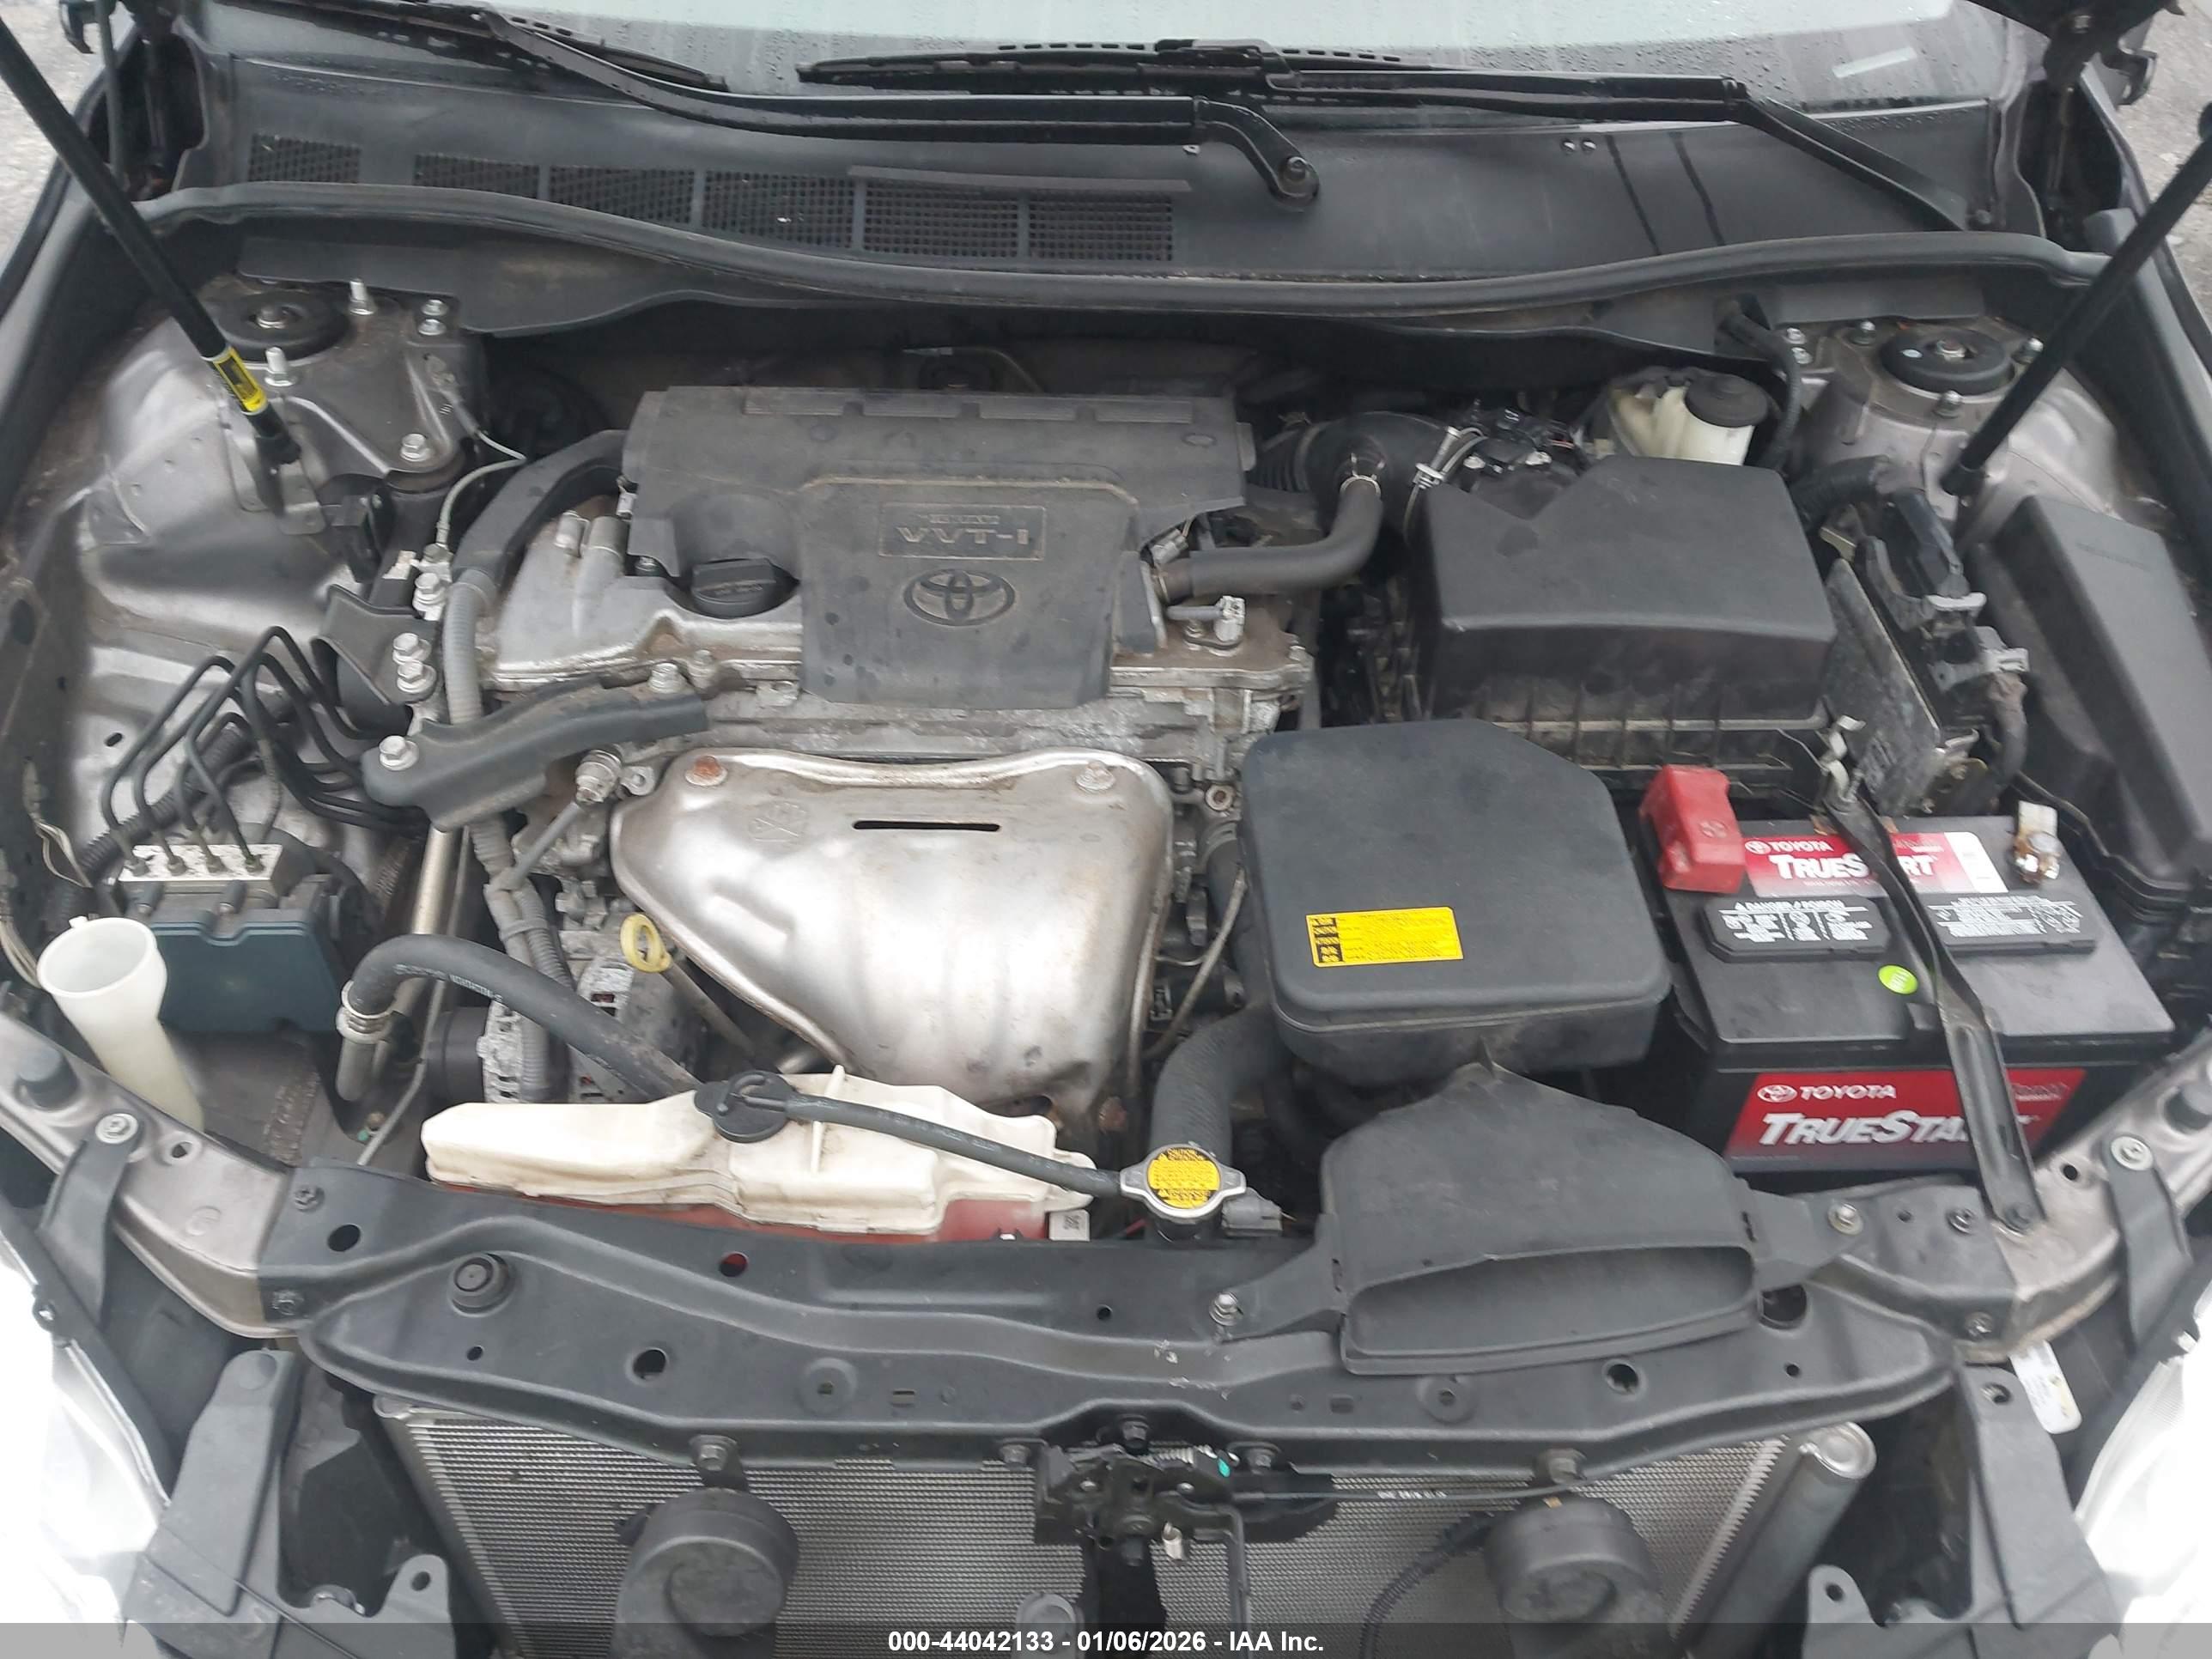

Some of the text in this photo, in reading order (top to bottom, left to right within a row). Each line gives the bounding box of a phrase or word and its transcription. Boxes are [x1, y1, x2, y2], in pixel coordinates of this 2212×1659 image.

[1767, 841, 1834, 852] TOYOTA
[1769, 853, 1938, 879] TRUESRT
[1801, 1085, 1897, 1100] TOYOTA
[1759, 1110, 2032, 1145] TRUESTA
